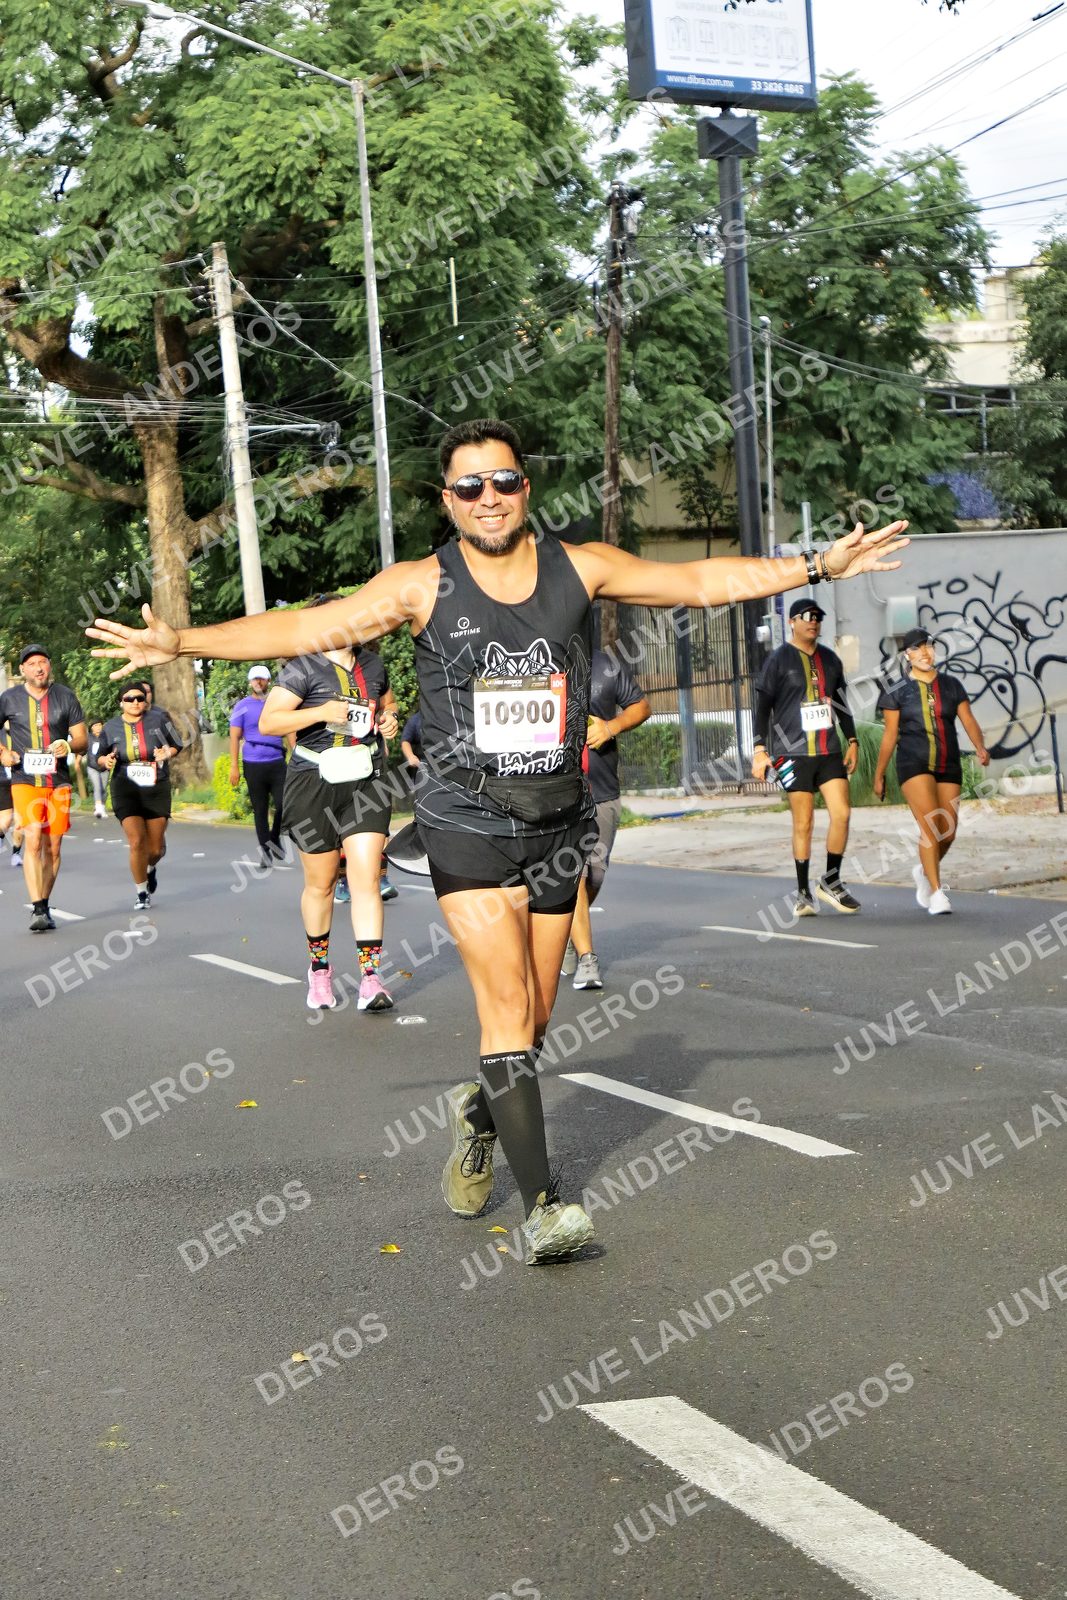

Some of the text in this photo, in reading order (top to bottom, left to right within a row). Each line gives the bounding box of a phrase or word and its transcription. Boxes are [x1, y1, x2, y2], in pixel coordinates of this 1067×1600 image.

[918, 571, 1002, 603] TOY
[449, 627, 481, 638] TOPTIME
[480, 700, 555, 725] 10900
[804, 708, 829, 720] 13191
[498, 752, 522, 769] LA
[483, 1055, 526, 1065] TOPTIME
